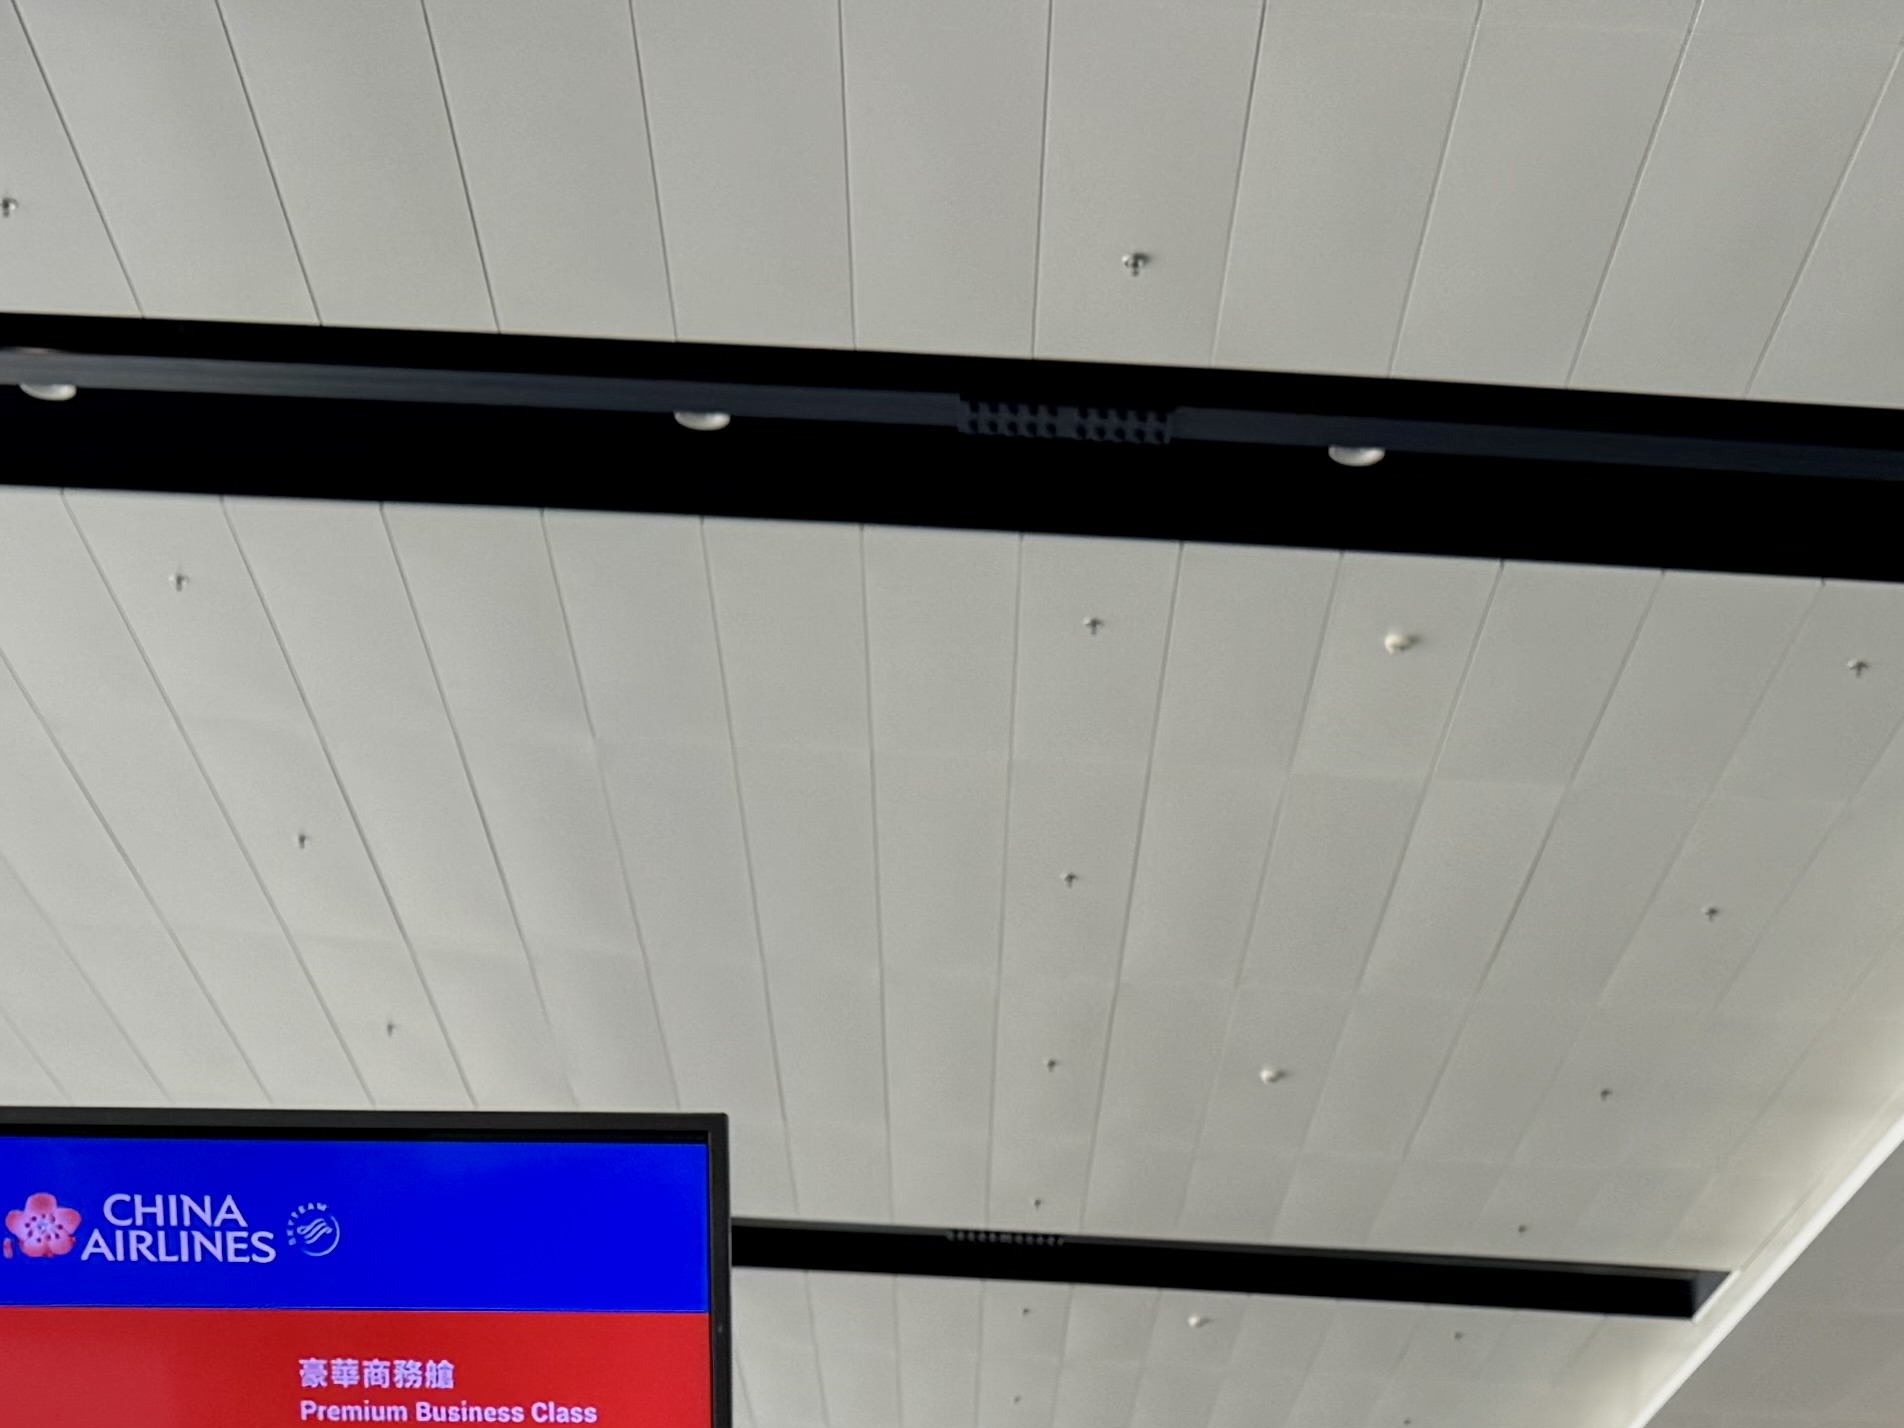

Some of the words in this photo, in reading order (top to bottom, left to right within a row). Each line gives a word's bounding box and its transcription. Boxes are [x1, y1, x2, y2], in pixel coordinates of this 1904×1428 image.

[103, 1193, 247, 1227] CHINA
[81, 1228, 277, 1265] AIRLINES
[299, 1357, 455, 1389] 豪華商務艙
[300, 1400, 408, 1422] Premium
[415, 1400, 524, 1423] Business
[531, 1402, 598, 1424] Class
